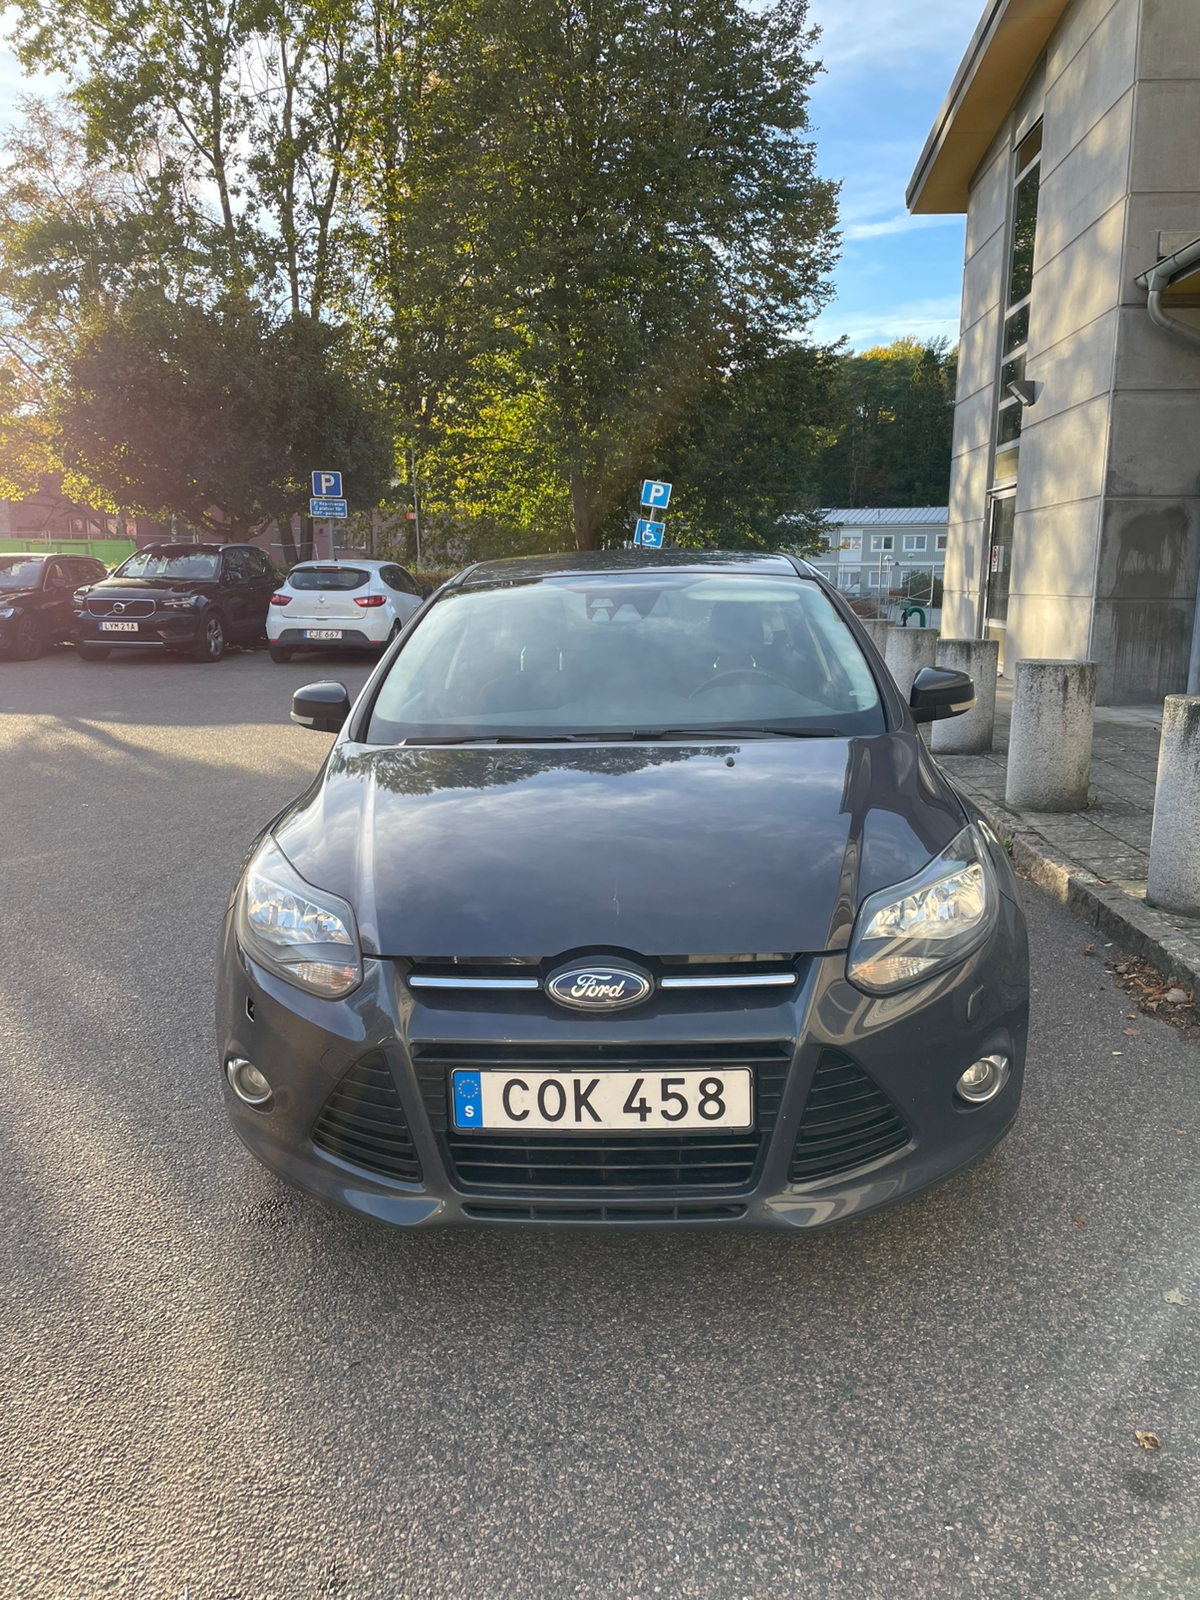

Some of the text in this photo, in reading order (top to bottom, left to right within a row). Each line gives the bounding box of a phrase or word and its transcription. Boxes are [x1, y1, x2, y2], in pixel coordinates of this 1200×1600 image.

[321, 474, 335, 494] P
[649, 484, 664, 503] P
[570, 973, 626, 998] Ford
[502, 1077, 726, 1123] COK 458
[464, 1105, 475, 1118] S
